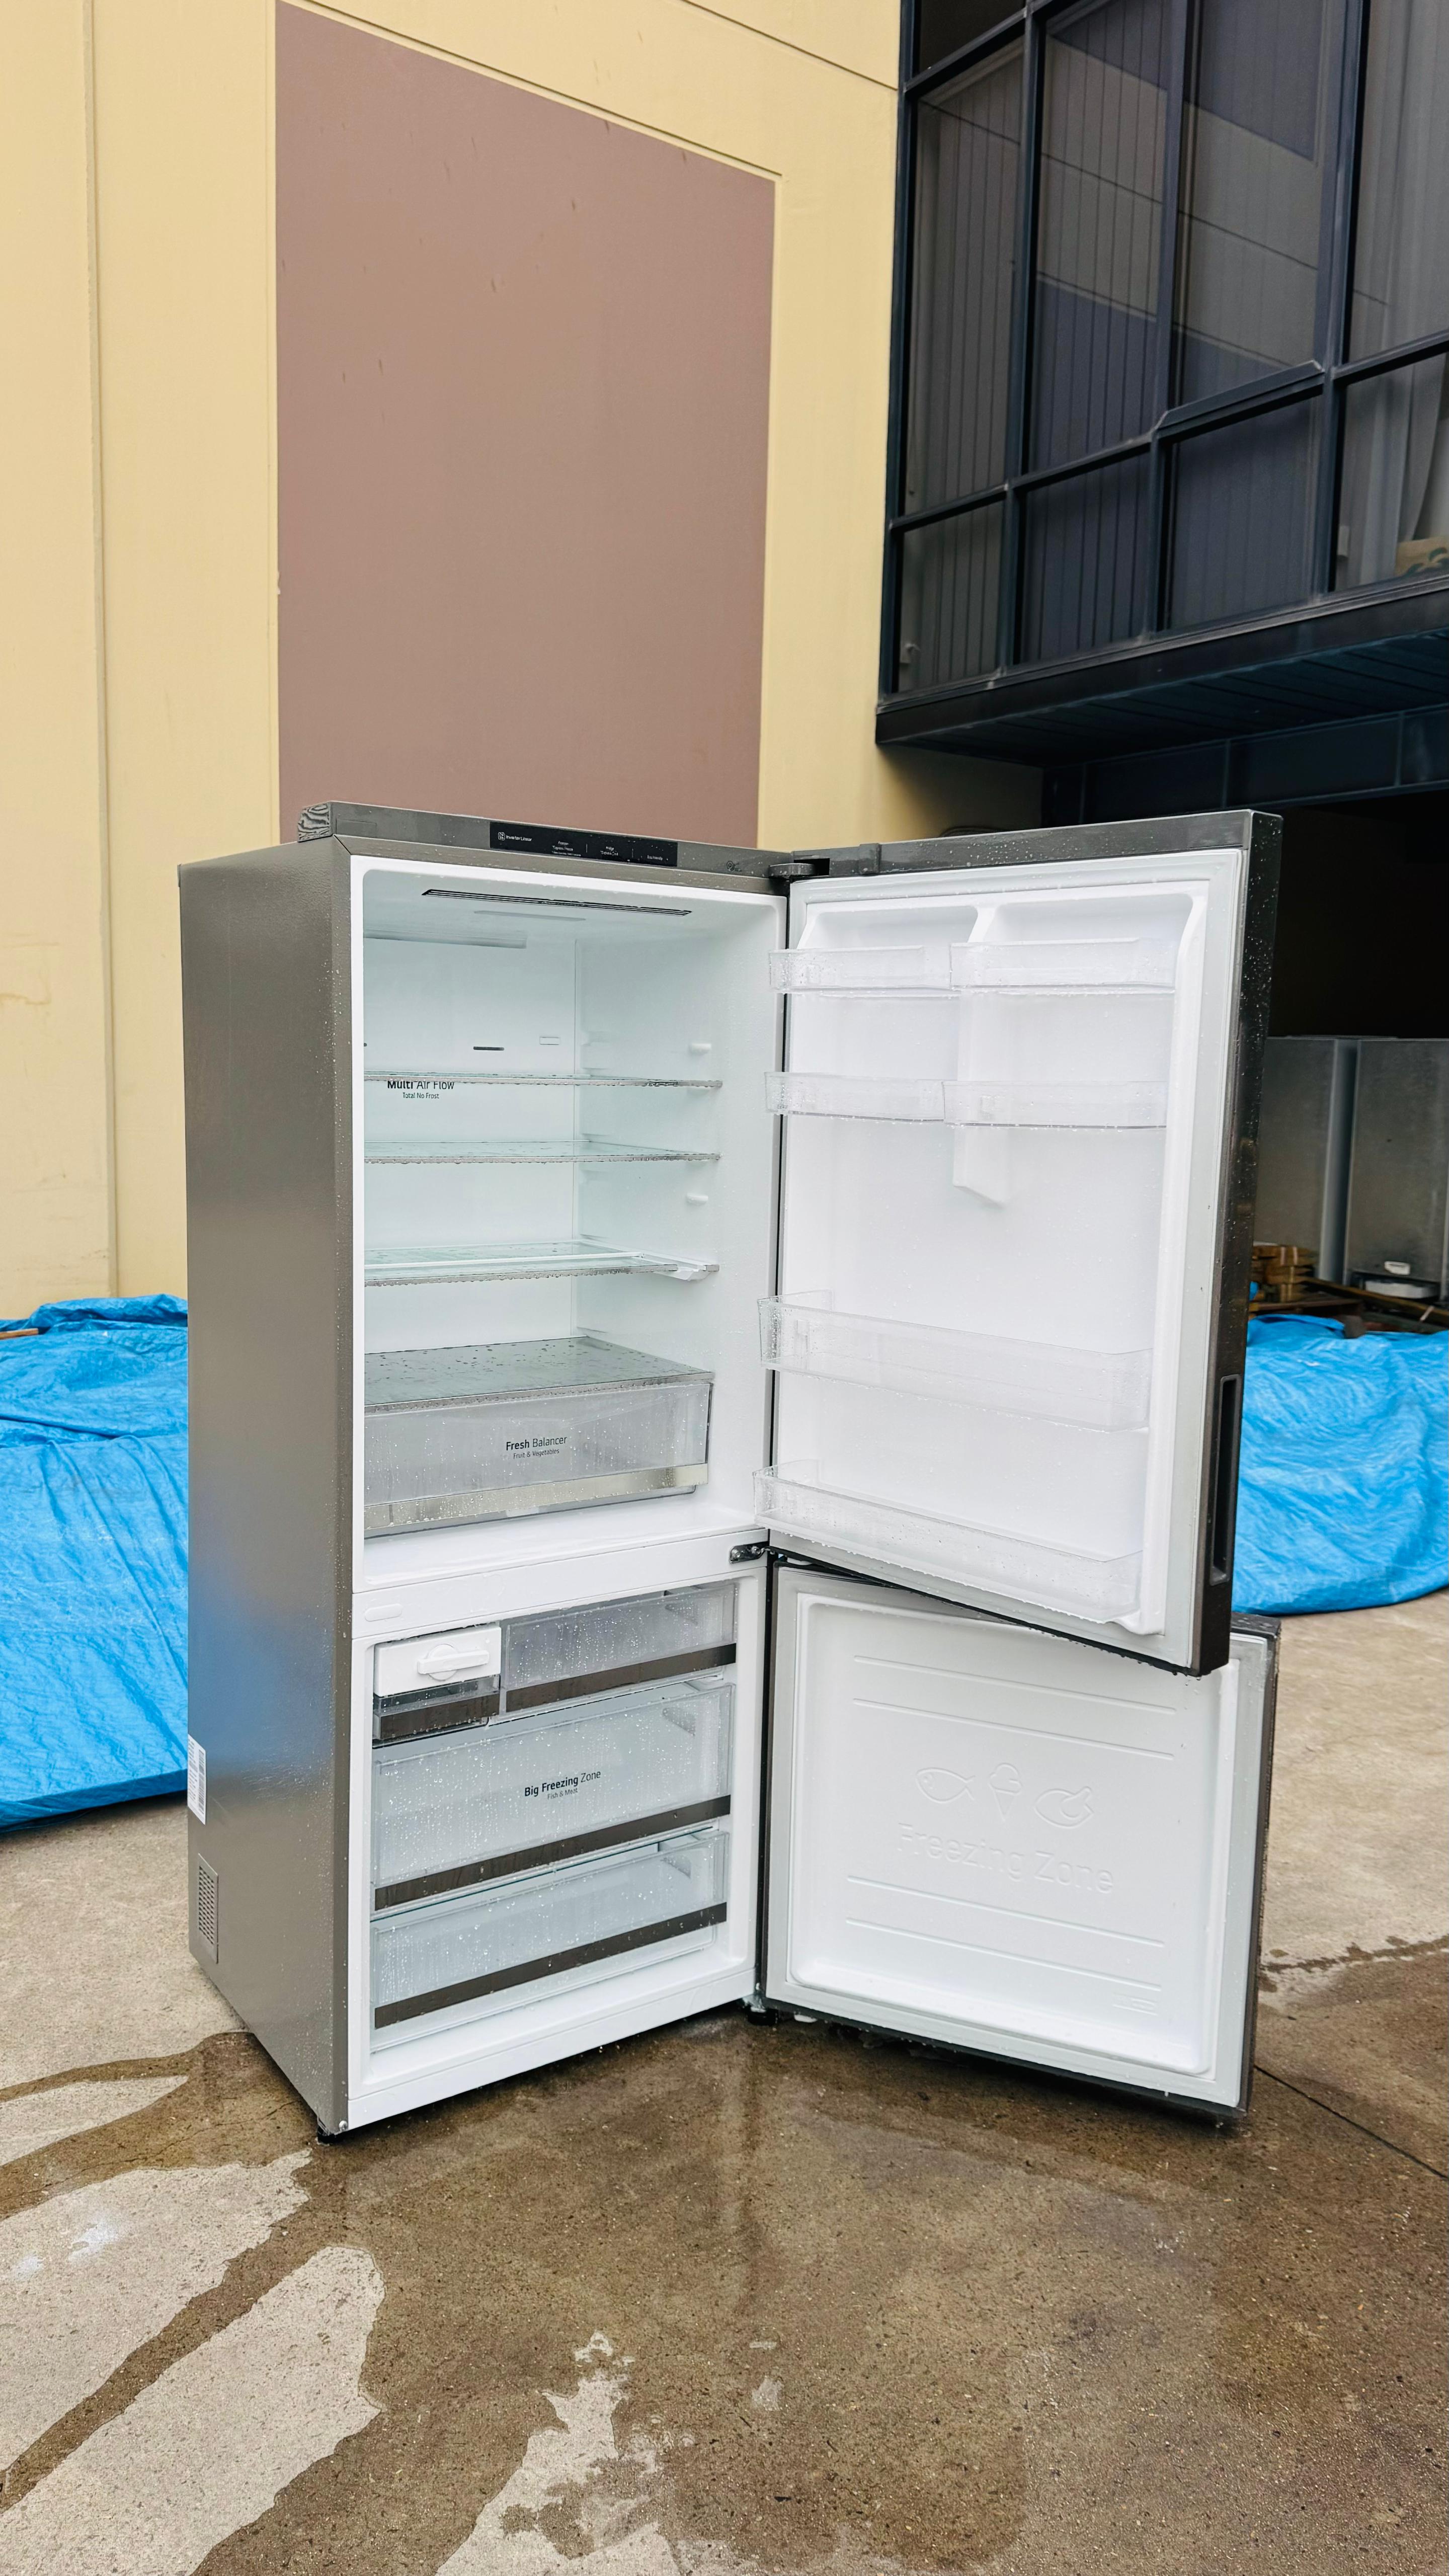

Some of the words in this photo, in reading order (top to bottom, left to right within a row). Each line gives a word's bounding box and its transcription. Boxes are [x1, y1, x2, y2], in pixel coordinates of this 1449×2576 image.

[387, 1080, 413, 1089] Multi
[416, 1080, 430, 1089] Air
[433, 1081, 454, 1089] Flow
[506, 1439, 530, 1451] Fresh
[532, 1436, 568, 1447] Balancer
[532, 1448, 559, 1457] Vegetables
[524, 1786, 539, 1797] Big
[542, 1777, 579, 1792] Freezing
[581, 1771, 601, 1783] Zone
[565, 1788, 578, 1796] Meat
[897, 1822, 1025, 1882] Freezing
[1034, 1850, 1113, 1894] Zone
